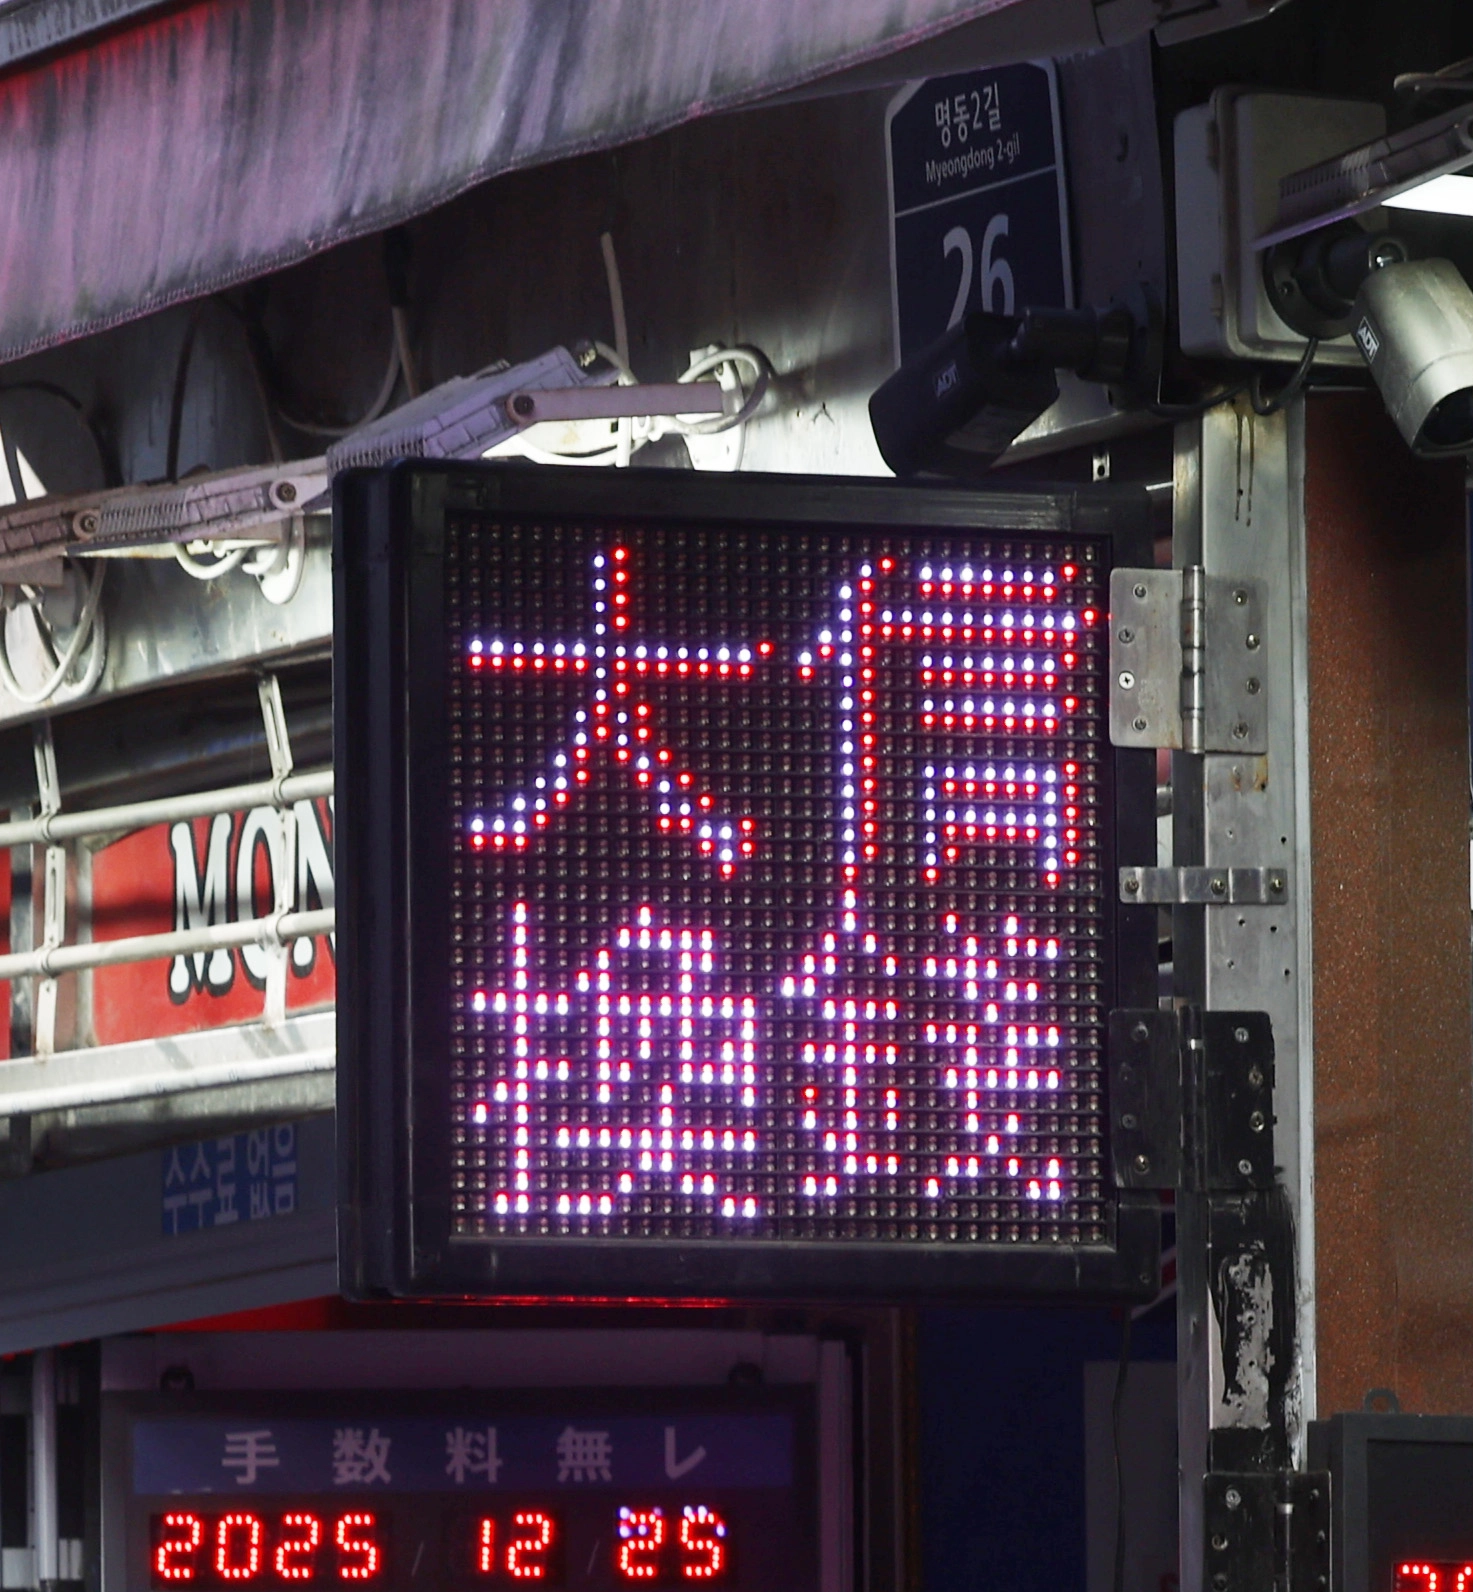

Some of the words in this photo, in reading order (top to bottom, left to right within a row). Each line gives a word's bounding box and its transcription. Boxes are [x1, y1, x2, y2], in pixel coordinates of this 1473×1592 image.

[934, 82, 1002, 148] 명동2길
[925, 146, 995, 184] Myeongdong
[996, 132, 1021, 165] 2-gil
[942, 213, 1016, 330] 26
[1358, 321, 1380, 361] ADT
[934, 361, 959, 396] ADT
[468, 546, 1097, 884] 大信
[153, 1511, 382, 1581] 2025
[477, 1511, 556, 1580] 12
[615, 1503, 730, 1581] 25
